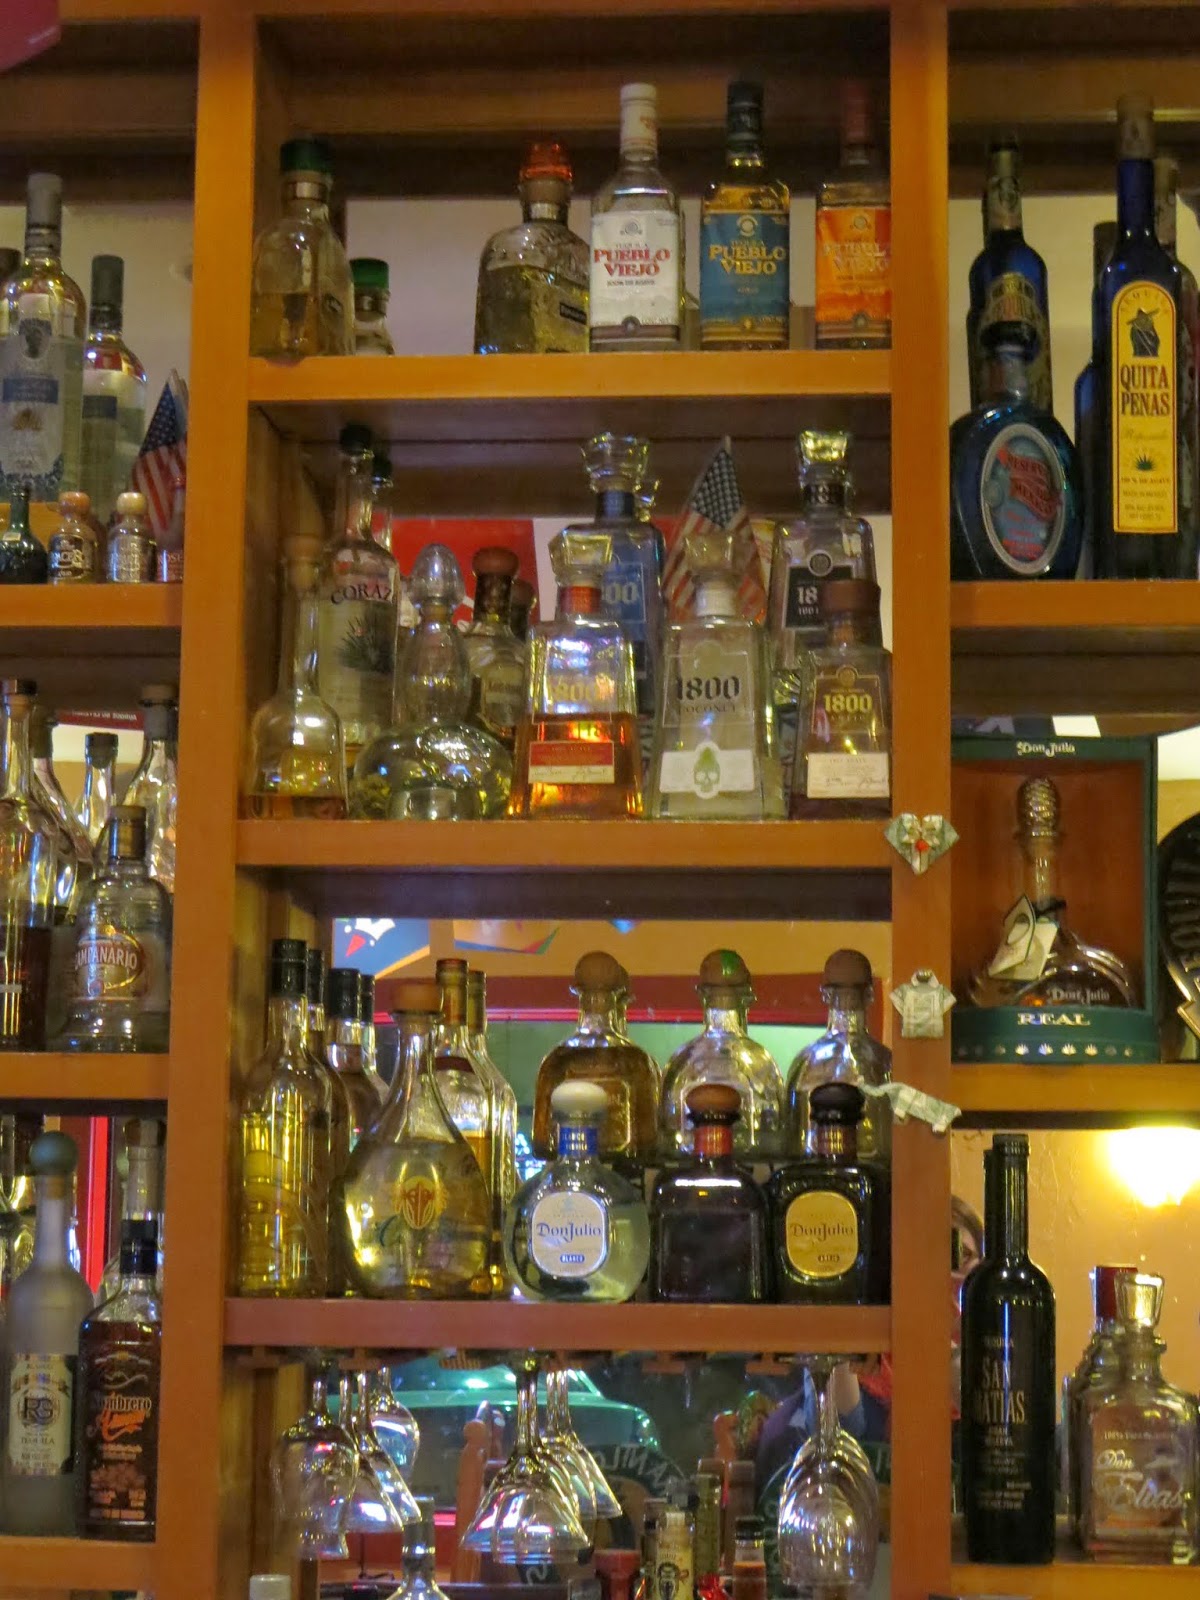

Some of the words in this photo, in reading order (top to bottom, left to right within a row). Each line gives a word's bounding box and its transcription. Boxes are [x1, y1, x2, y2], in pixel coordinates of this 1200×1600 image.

[594, 248, 670, 263] PUEBLO
[709, 244, 786, 260] PUEBLO
[604, 263, 660, 277] VIEJO
[720, 259, 777, 275] VIEJO
[1120, 365, 1169, 391] QUITA
[675, 676, 740, 700] 1800
[823, 693, 873, 713] 1800
[1017, 1012, 1091, 1026] REAL
[980, 1357, 1012, 1389] SAN
